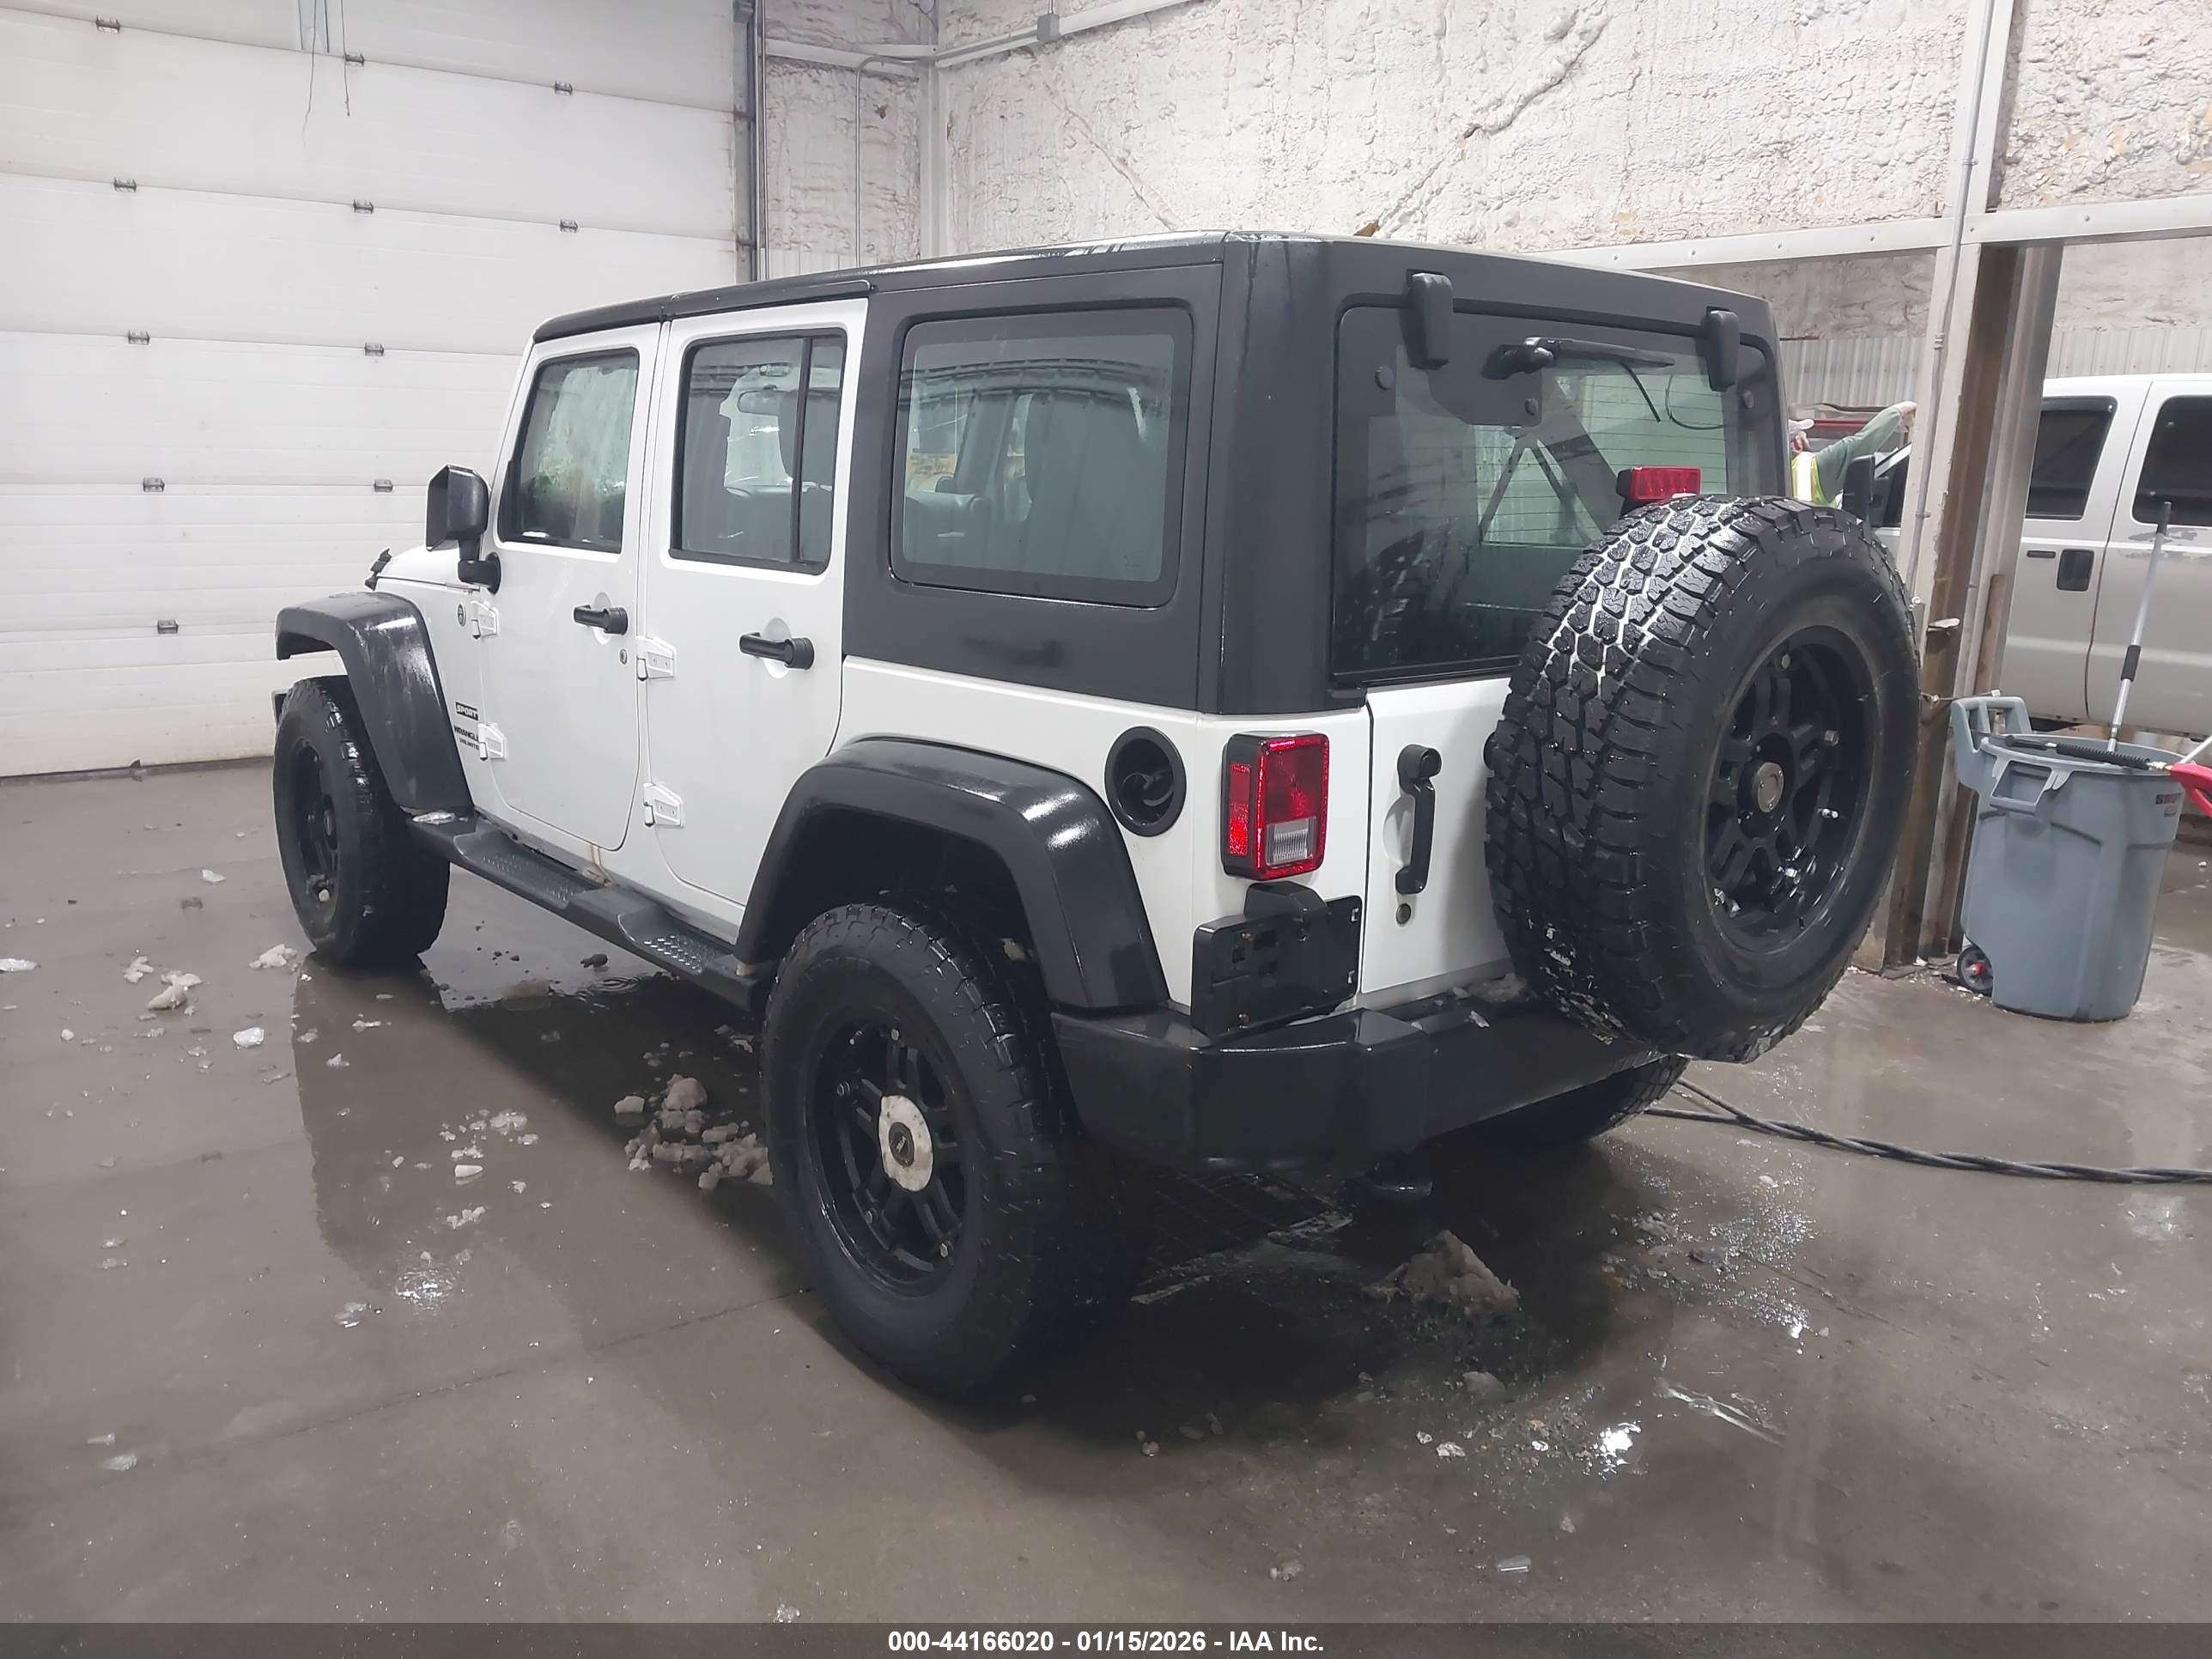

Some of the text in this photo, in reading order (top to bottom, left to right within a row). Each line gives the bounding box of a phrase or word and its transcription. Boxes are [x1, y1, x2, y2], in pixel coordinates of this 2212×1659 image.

[456, 703, 478, 720] SPORT
[453, 725, 479, 742] WRANGLE
[459, 737, 480, 750] UNLIMITE
